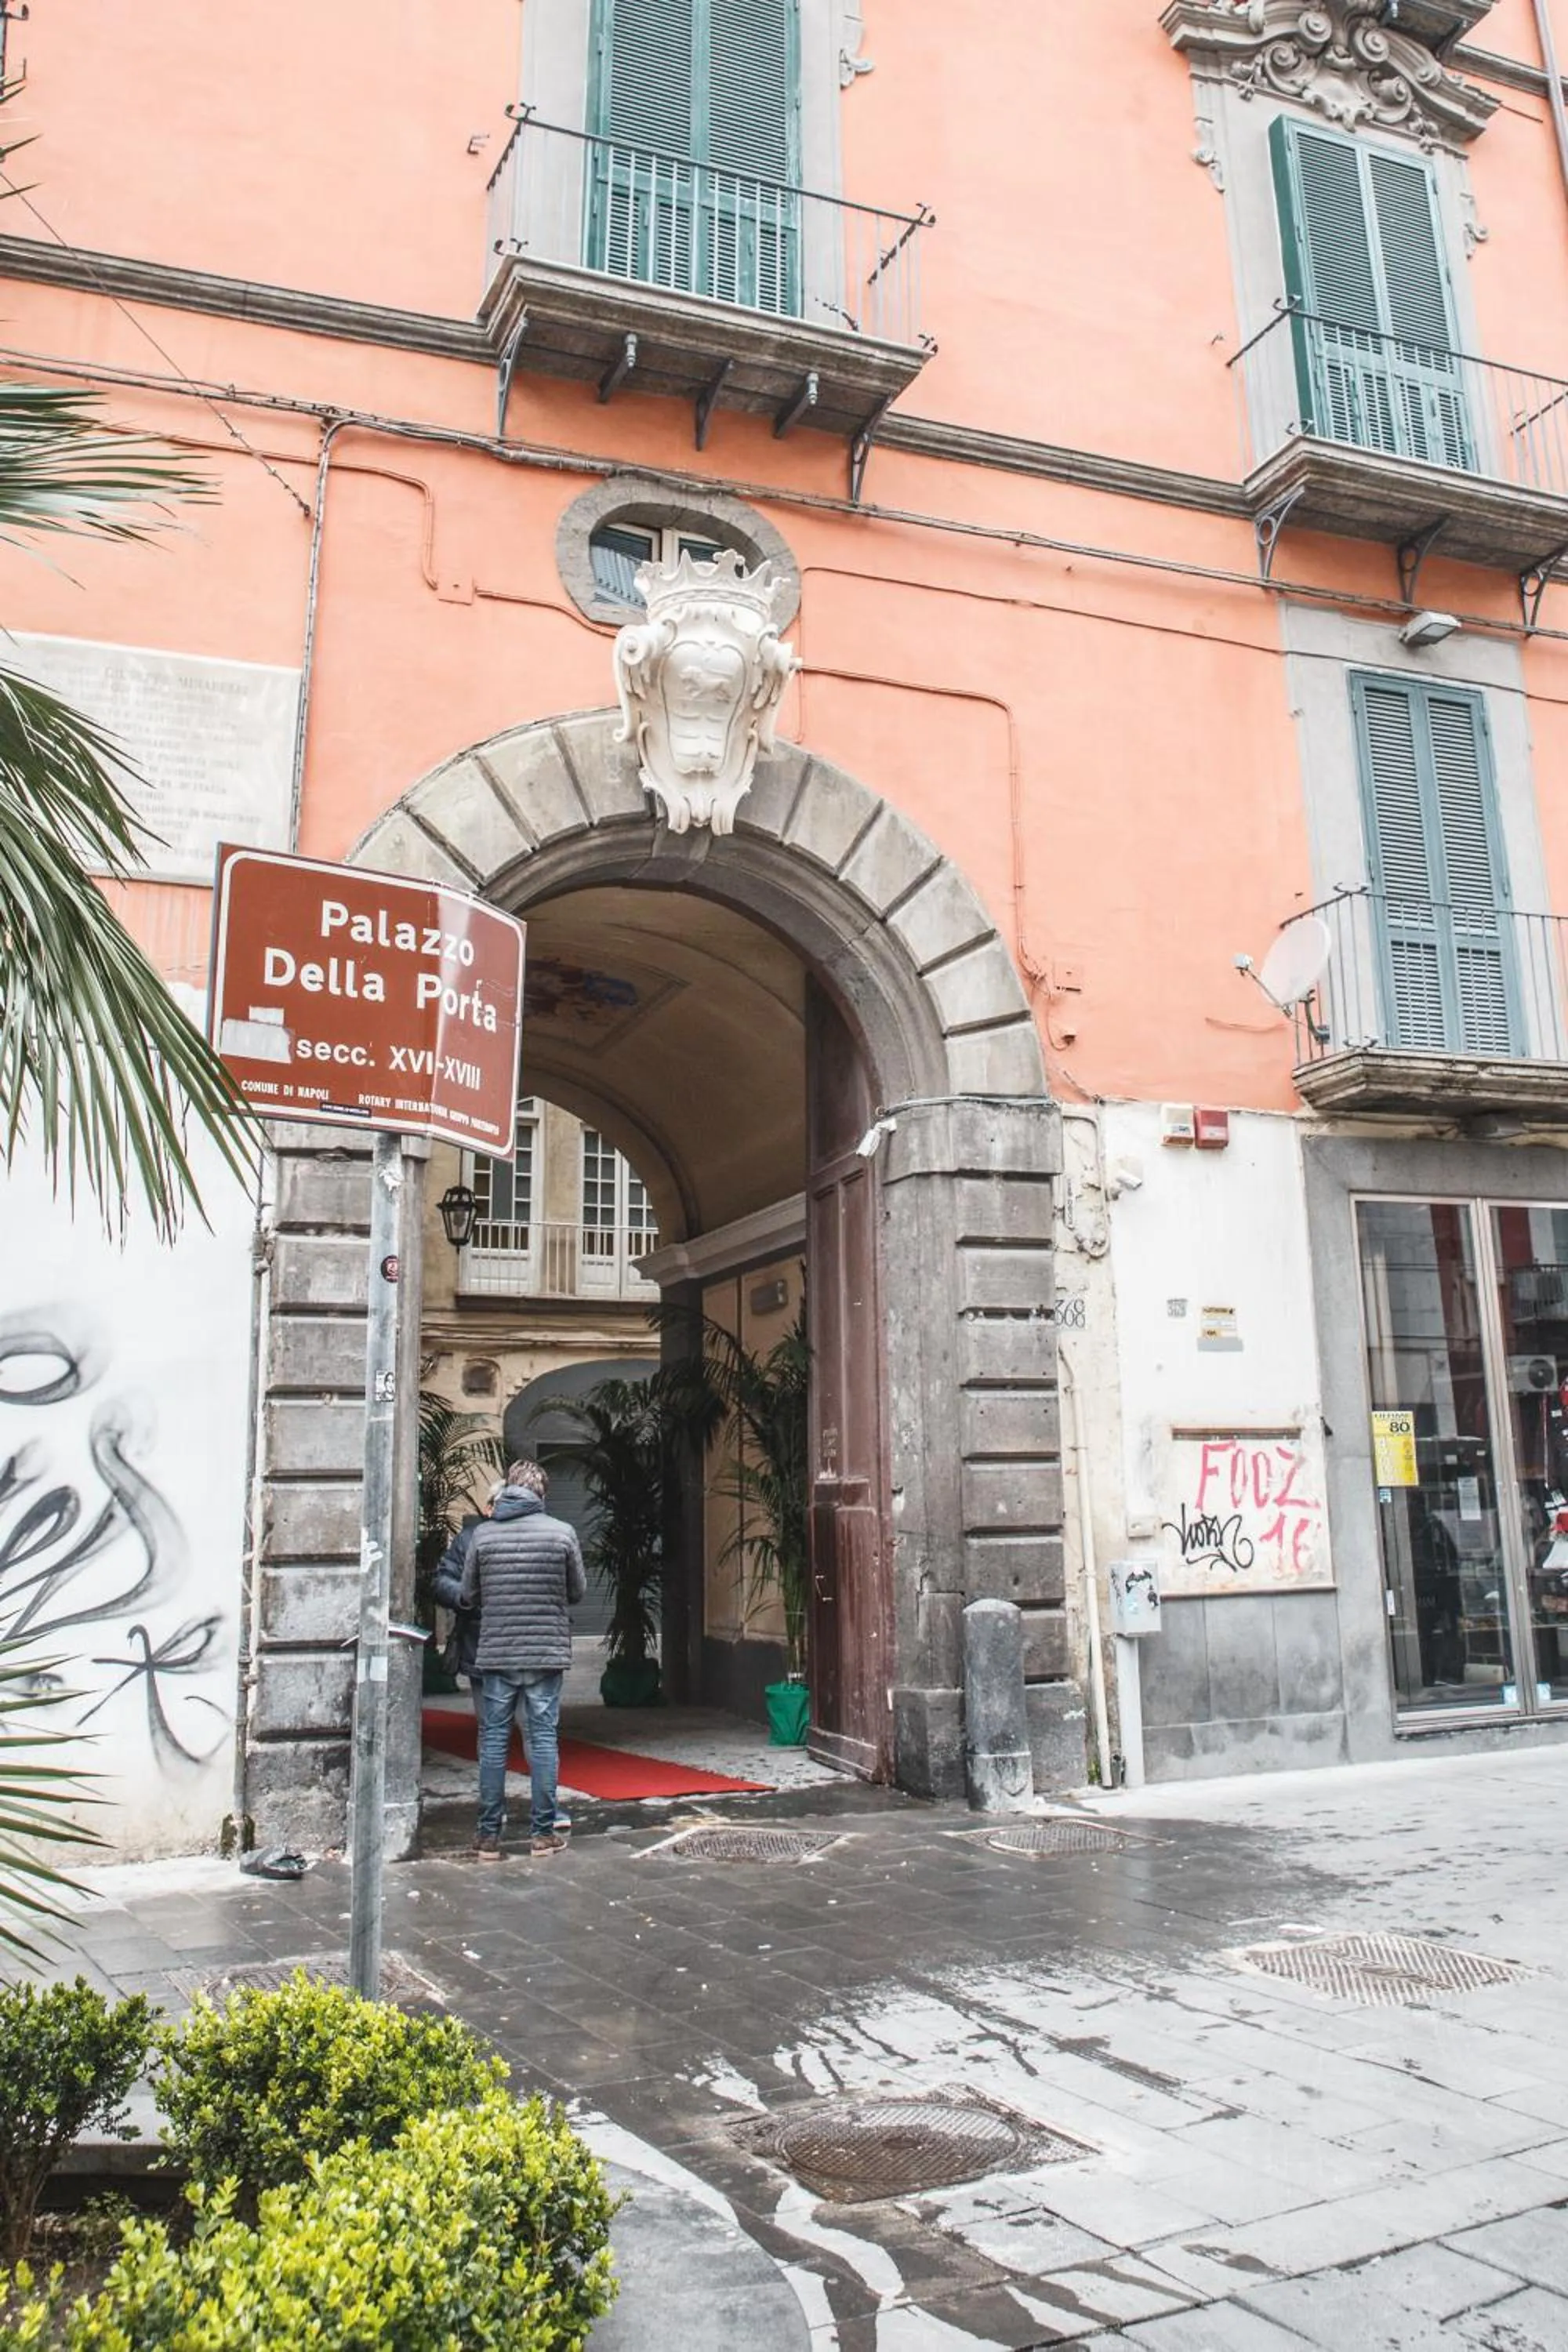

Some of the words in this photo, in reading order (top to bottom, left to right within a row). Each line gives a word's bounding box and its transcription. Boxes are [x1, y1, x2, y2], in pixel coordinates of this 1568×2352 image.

[320, 899, 474, 967] Palazzo
[263, 946, 386, 1003] Della
[416, 972, 497, 1033] Porta
[296, 1038, 376, 1067] secc.
[389, 1044, 481, 1091] XVI-XVIII
[241, 1080, 279, 1095] COMUNE
[283, 1084, 294, 1096] DI
[297, 1086, 330, 1100] NAPOLI
[358, 1093, 391, 1108] ROTARY
[1053, 1298, 1086, 1329] 368
[1389, 1421, 1410, 1433] 80
